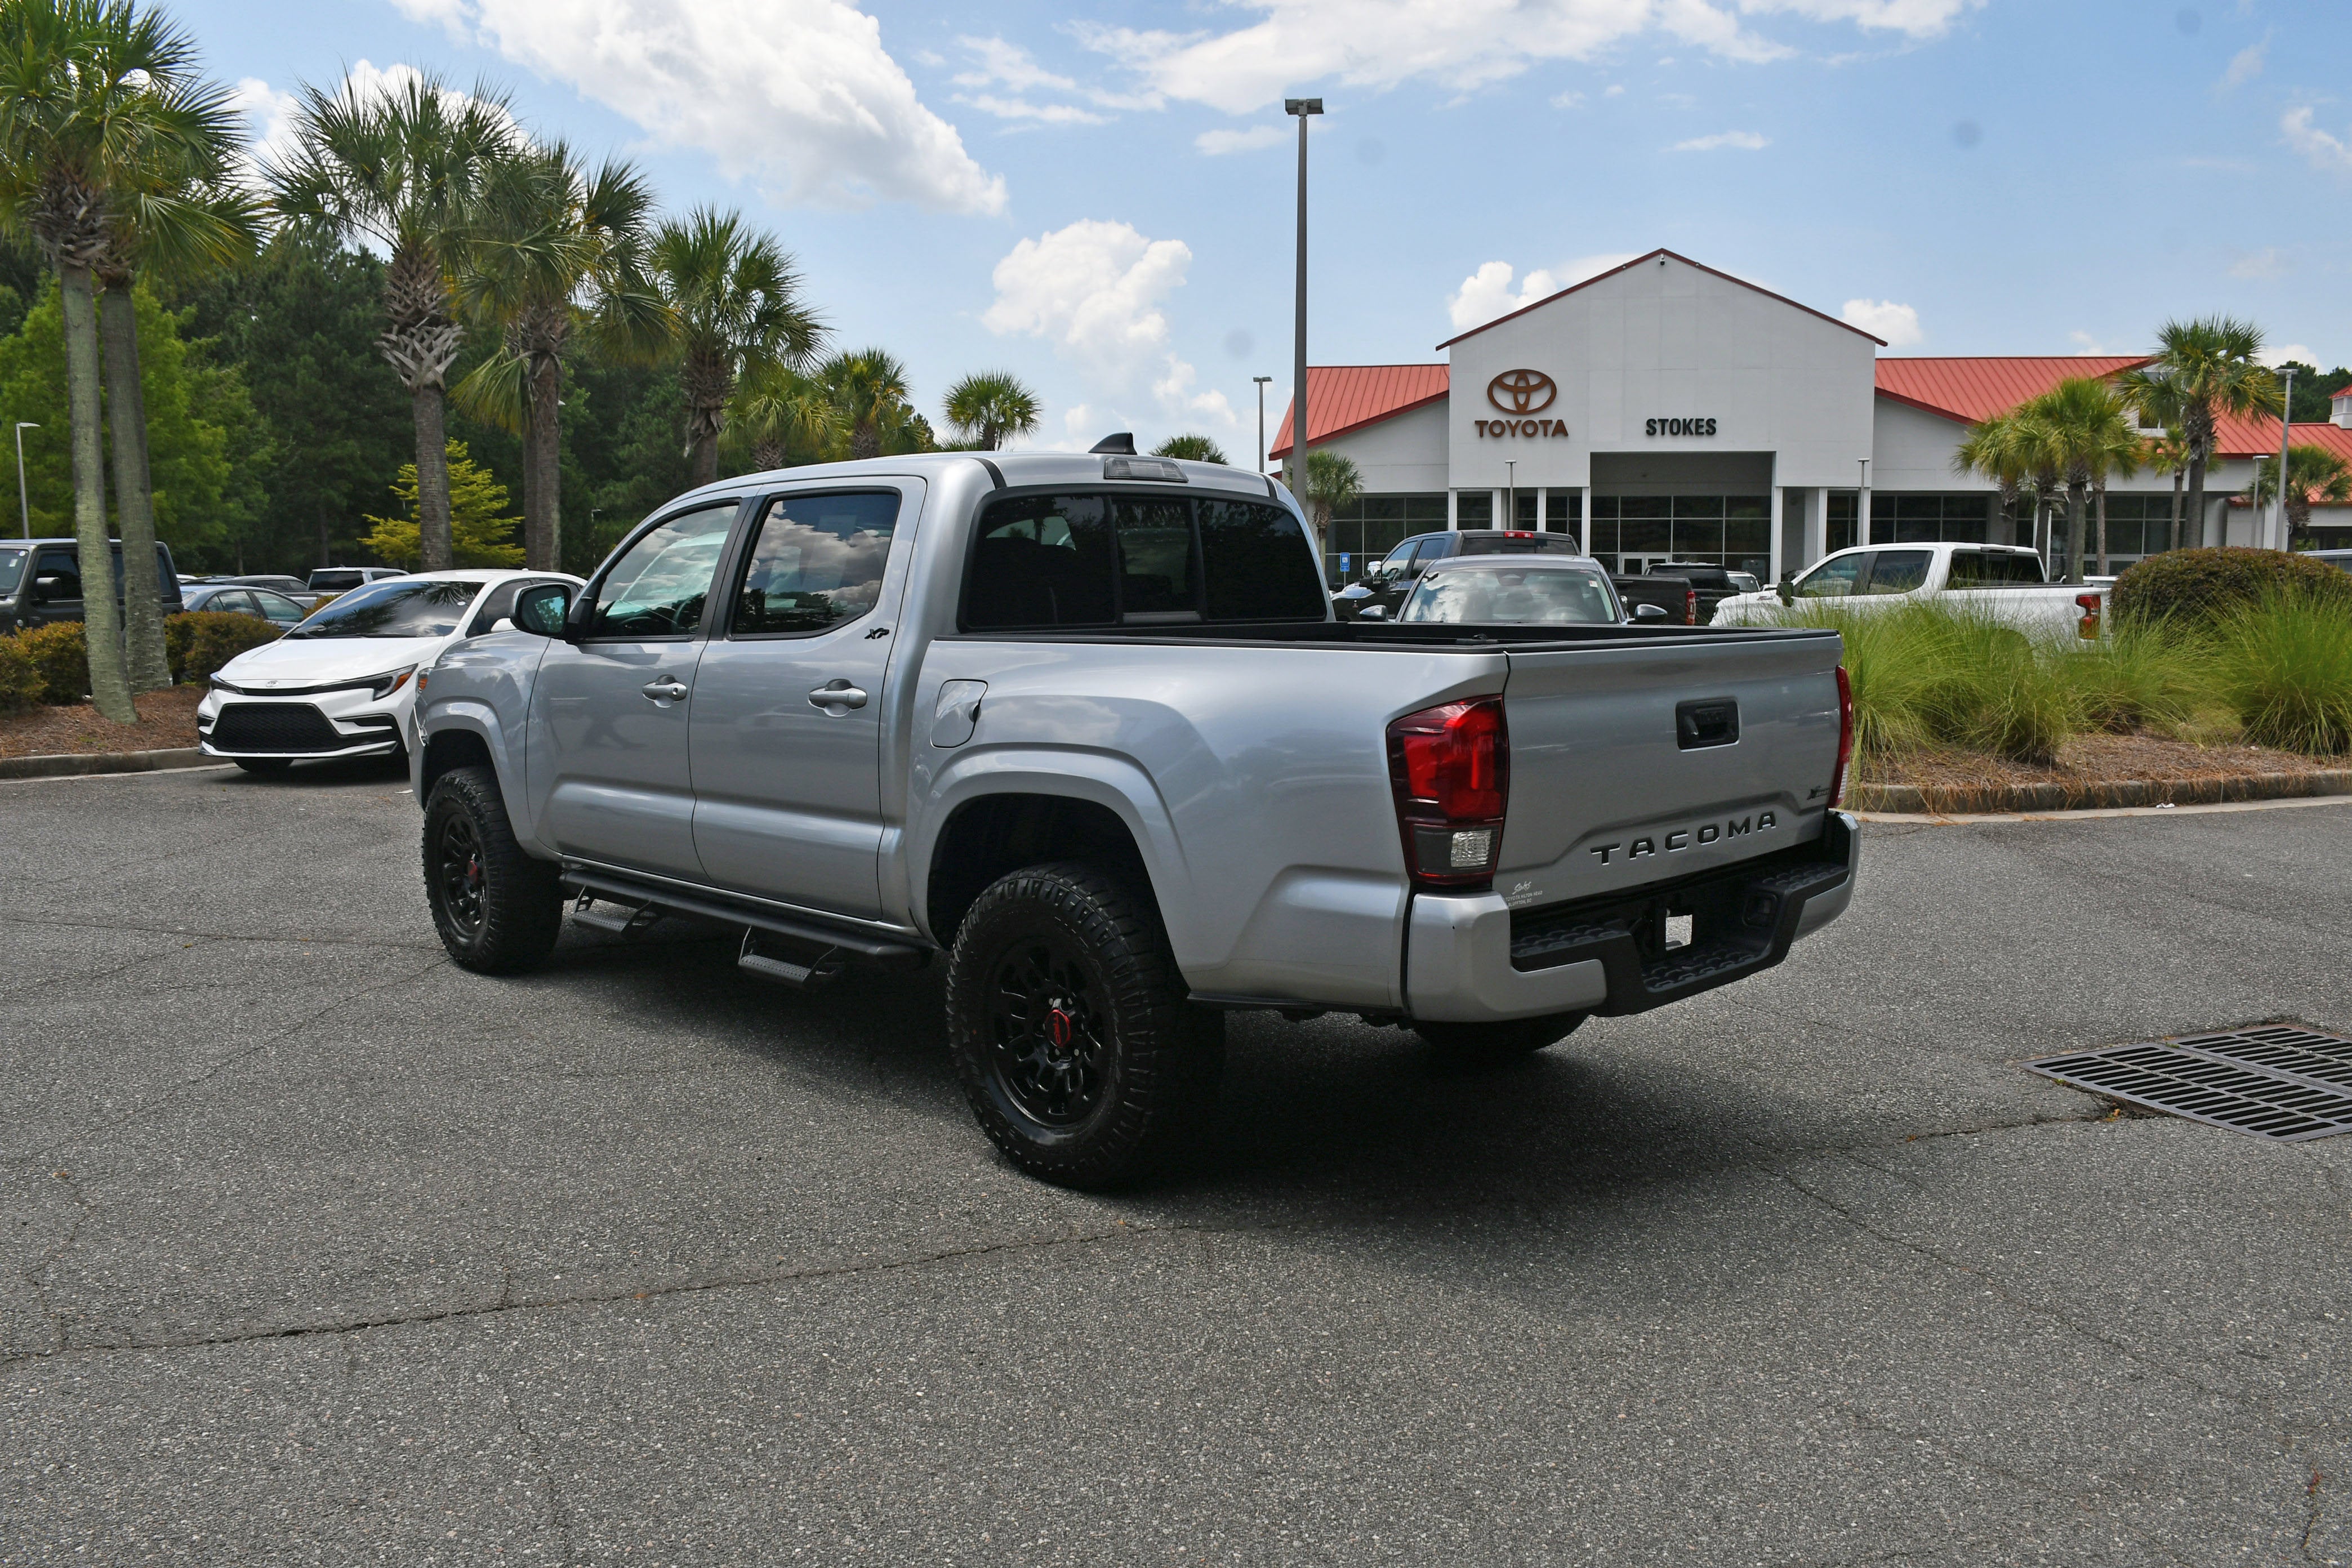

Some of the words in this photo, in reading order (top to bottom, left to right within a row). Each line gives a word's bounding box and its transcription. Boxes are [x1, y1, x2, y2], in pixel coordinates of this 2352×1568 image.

[1475, 420, 1569, 438] TOYOTA
[1646, 418, 1717, 436] STOKES
[864, 627, 890, 640] XP
[1590, 810, 1776, 866] TACOMA
